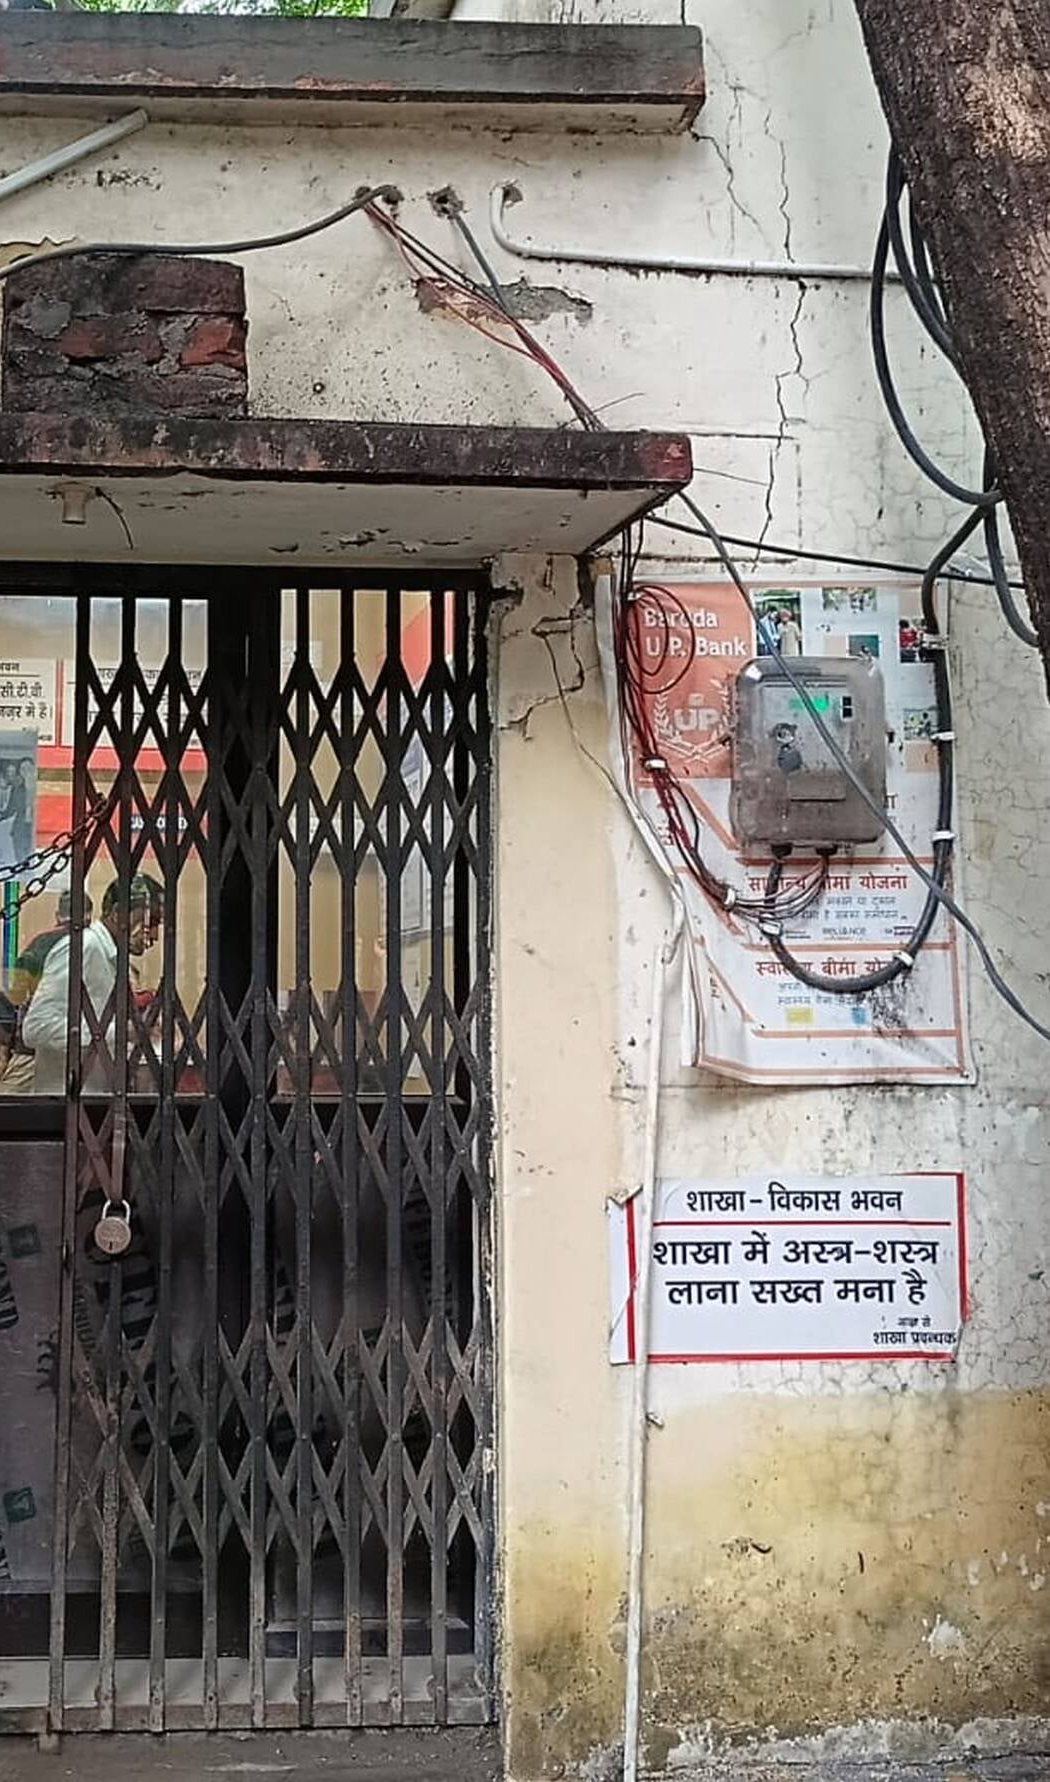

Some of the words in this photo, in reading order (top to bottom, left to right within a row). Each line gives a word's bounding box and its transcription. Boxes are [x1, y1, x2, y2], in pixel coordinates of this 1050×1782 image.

[696, 636, 747, 656] Bank
[859, 872, 908, 890] योजना
[687, 1190, 746, 1212] शाखा
[768, 1181, 841, 1211] विकास
[851, 1190, 903, 1212] भवन
[653, 1240, 732, 1265] शाखा
[742, 1231, 770, 1265] में
[666, 1281, 740, 1304] लाना
[750, 1280, 824, 1304] सख्त
[834, 1279, 895, 1303] मना
[901, 1269, 927, 1304] है
[873, 1331, 907, 1344] शाखा
